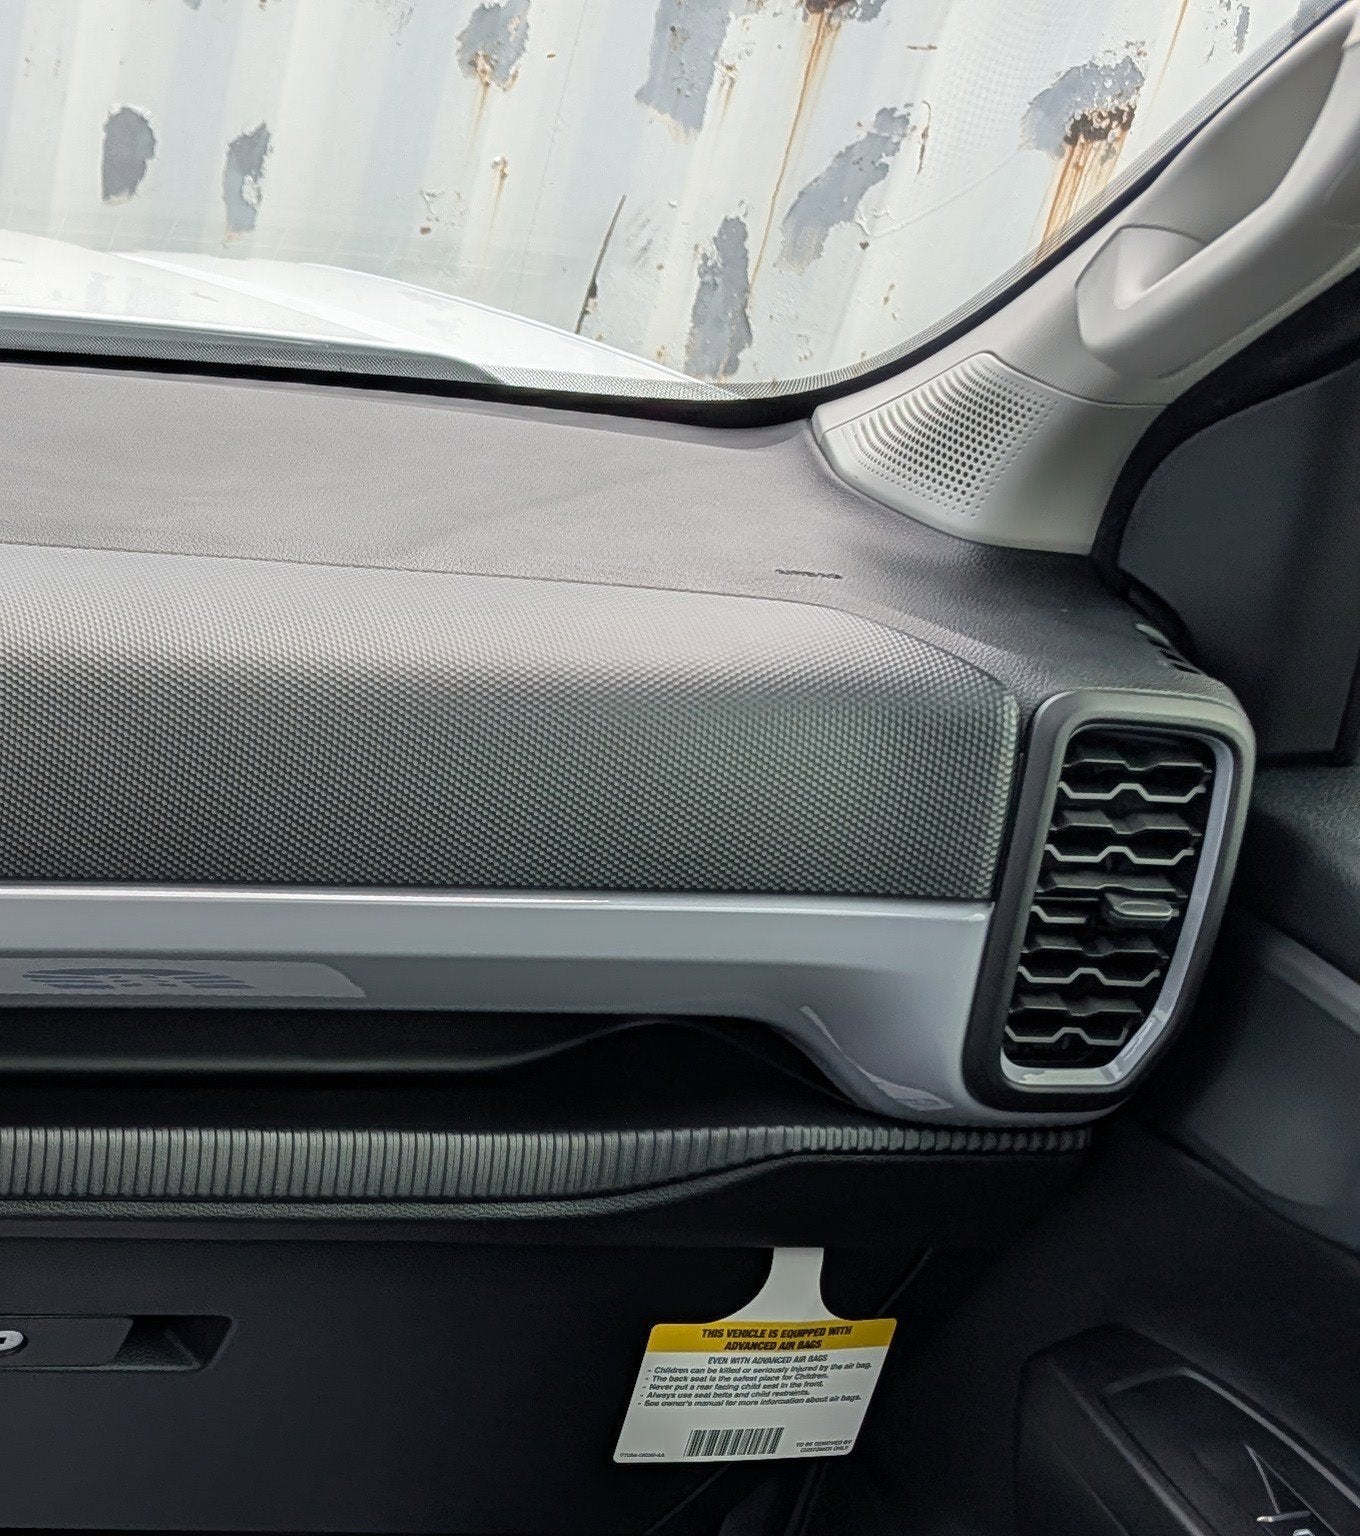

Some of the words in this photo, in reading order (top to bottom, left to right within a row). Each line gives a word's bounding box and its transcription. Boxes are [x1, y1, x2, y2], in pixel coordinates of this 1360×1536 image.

[701, 1328, 724, 1339] THIS
[726, 1328, 767, 1339] VEHICLE
[768, 1328, 779, 1338] IS
[780, 1327, 826, 1338] EQUIPPED
[828, 1326, 853, 1336] WITH
[724, 1341, 777, 1351] ADVANCED
[779, 1340, 796, 1350] AIR
[797, 1340, 822, 1349] BAGS
[707, 1356, 728, 1365] EVEN
[730, 1356, 750, 1365] WITH
[752, 1356, 792, 1365] ADVANCED
[793, 1355, 806, 1364] AIR
[807, 1354, 828, 1363] BAGS
